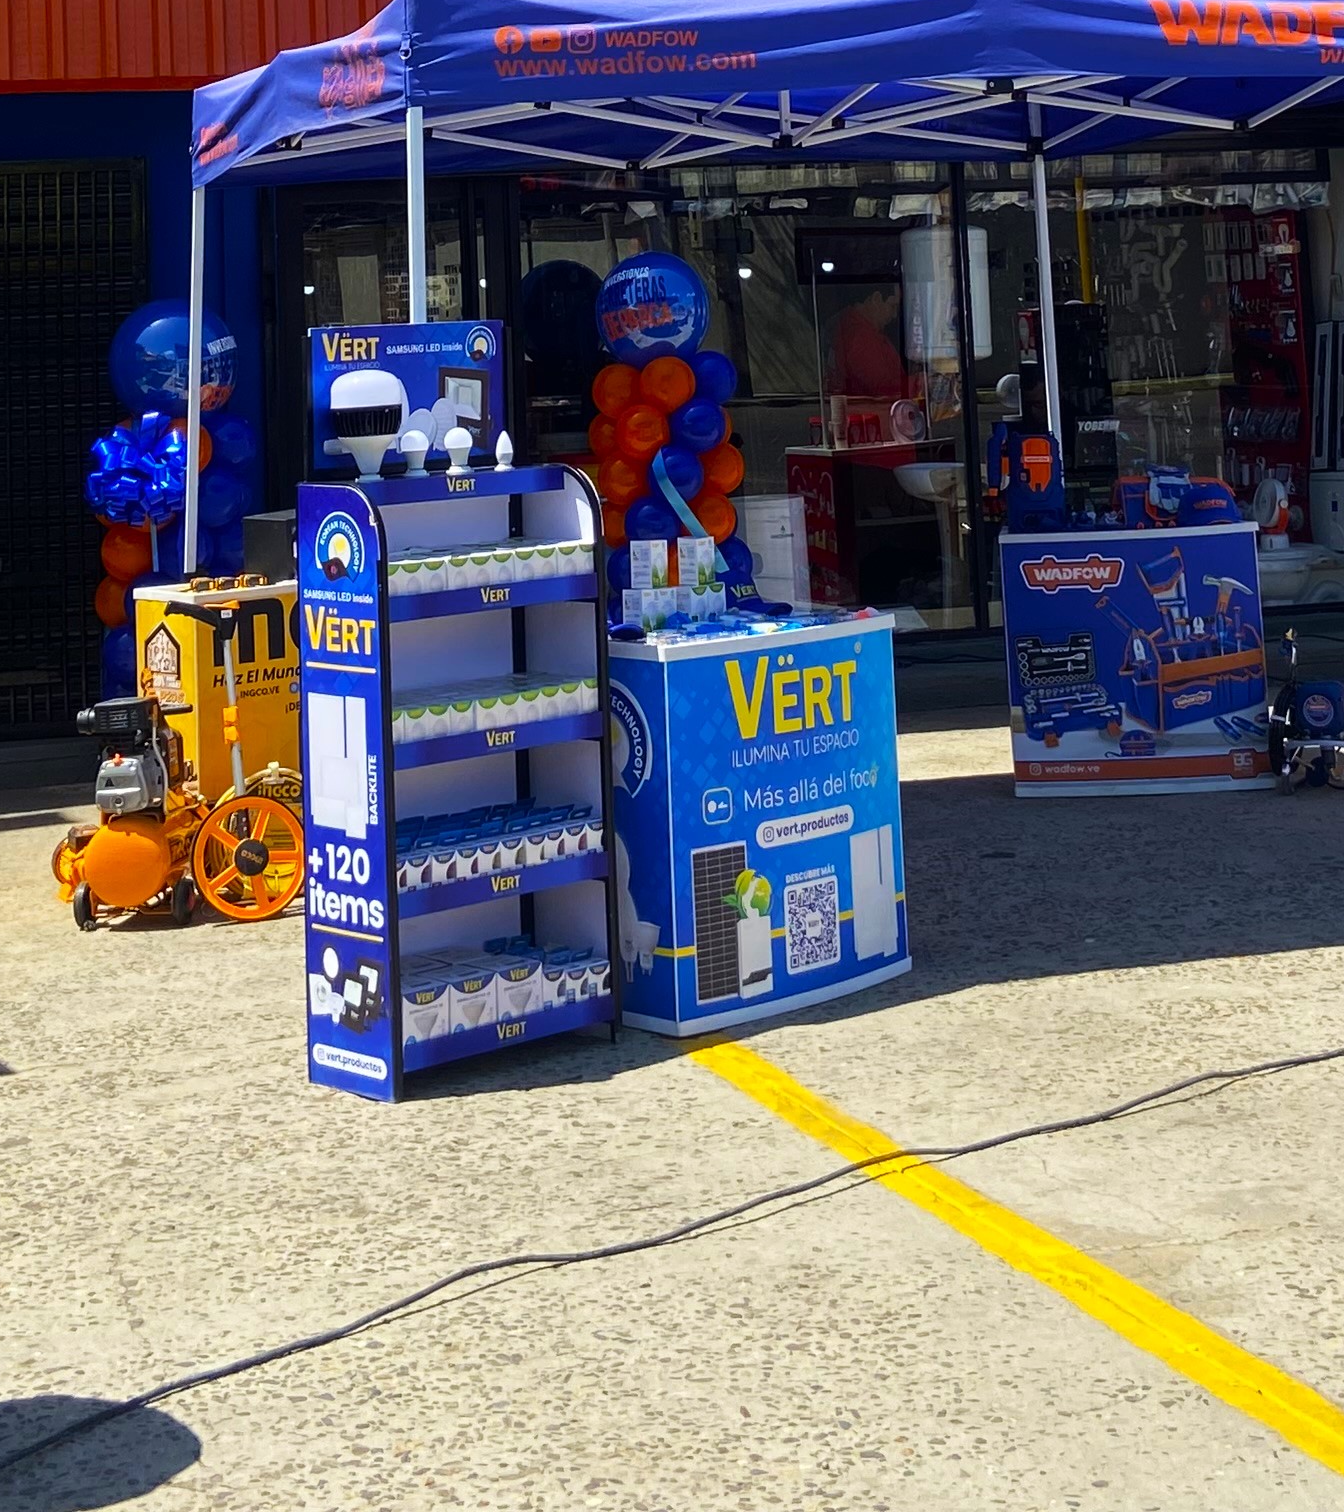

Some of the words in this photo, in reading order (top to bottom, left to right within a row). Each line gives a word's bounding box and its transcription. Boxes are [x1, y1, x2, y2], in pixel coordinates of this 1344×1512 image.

[605, 30, 699, 48] WADFOW
[494, 51, 757, 77] www.wadfow.com
[321, 332, 380, 362] VËRT
[386, 344, 424, 355] SAMSUNG
[425, 343, 441, 352] LED
[319, 519, 339, 546] KOREAN
[1033, 566, 1111, 582] WADFOW
[303, 588, 337, 602] SAMSUNG
[337, 591, 352, 603] LED
[304, 604, 376, 656] VËRT
[212, 673, 243, 688] Hz
[246, 667, 259, 684] El
[240, 685, 280, 699] INGCO.VE
[724, 653, 857, 740] VËRT
[731, 740, 791, 769] ILUMINA
[793, 738, 811, 757] TU
[812, 728, 860, 755] ESPACIO
[1044, 762, 1101, 775] wadfow.ve
[367, 754, 379, 826] BACKLITE
[743, 784, 784, 813] Más
[788, 776, 819, 804] allá
[822, 772, 848, 797] del
[849, 766, 878, 789] foco
[775, 813, 850, 838] vert.productos
[308, 842, 371, 886] +120
[785, 868, 822, 885] DESCUBRE
[820, 862, 836, 876] MÁS
[309, 876, 385, 929] items
[325, 1049, 383, 1075] vert.productos
